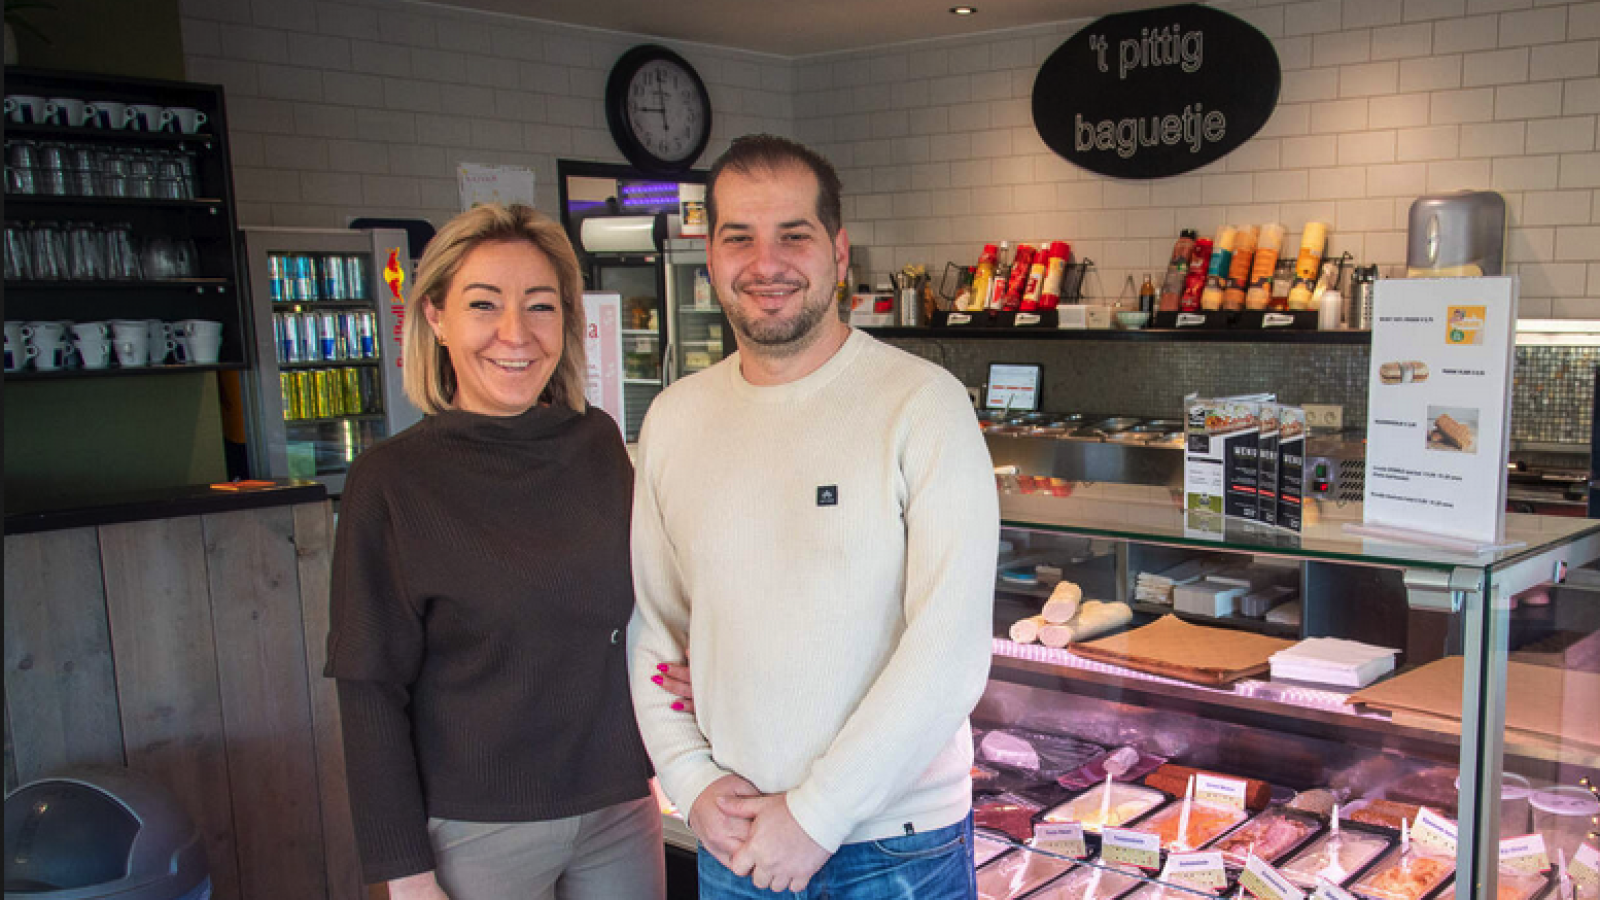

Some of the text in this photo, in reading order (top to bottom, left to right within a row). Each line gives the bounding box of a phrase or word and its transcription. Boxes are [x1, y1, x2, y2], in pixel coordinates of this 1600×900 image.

[1088, 23, 1203, 80] 't pittig
[1074, 102, 1226, 159] baguetje
